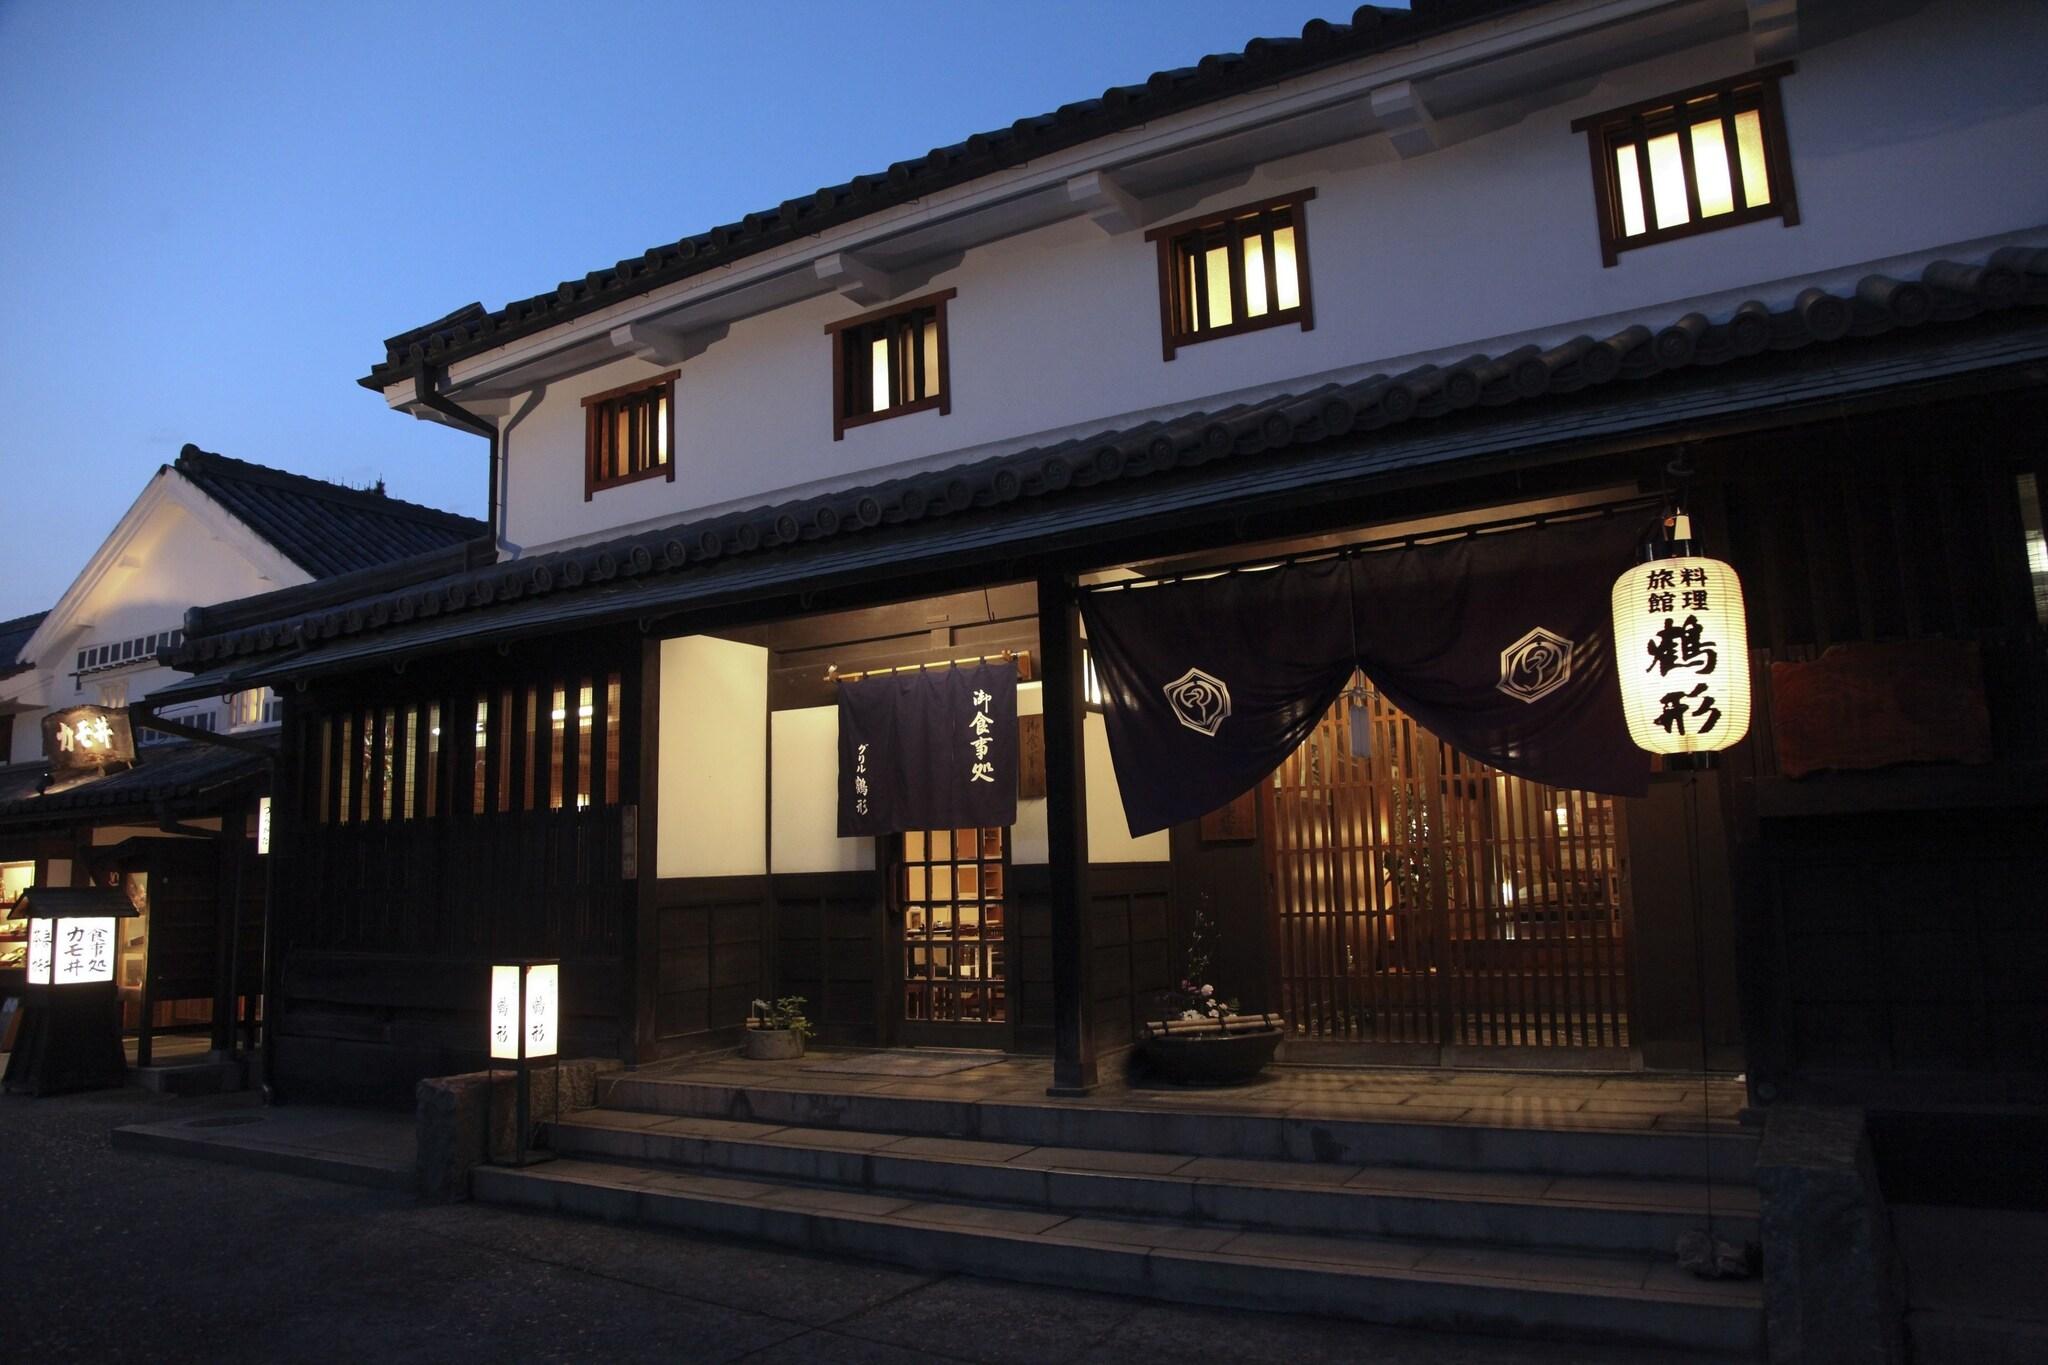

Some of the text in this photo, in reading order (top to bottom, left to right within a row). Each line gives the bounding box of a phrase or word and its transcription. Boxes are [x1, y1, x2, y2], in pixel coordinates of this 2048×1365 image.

[1646, 569, 1675, 614] 旅館
[1680, 567, 1710, 611] 料理
[1646, 615, 1723, 735] 鶴形
[968, 689, 995, 783] 御食事処
[64, 926, 85, 976] カモ井
